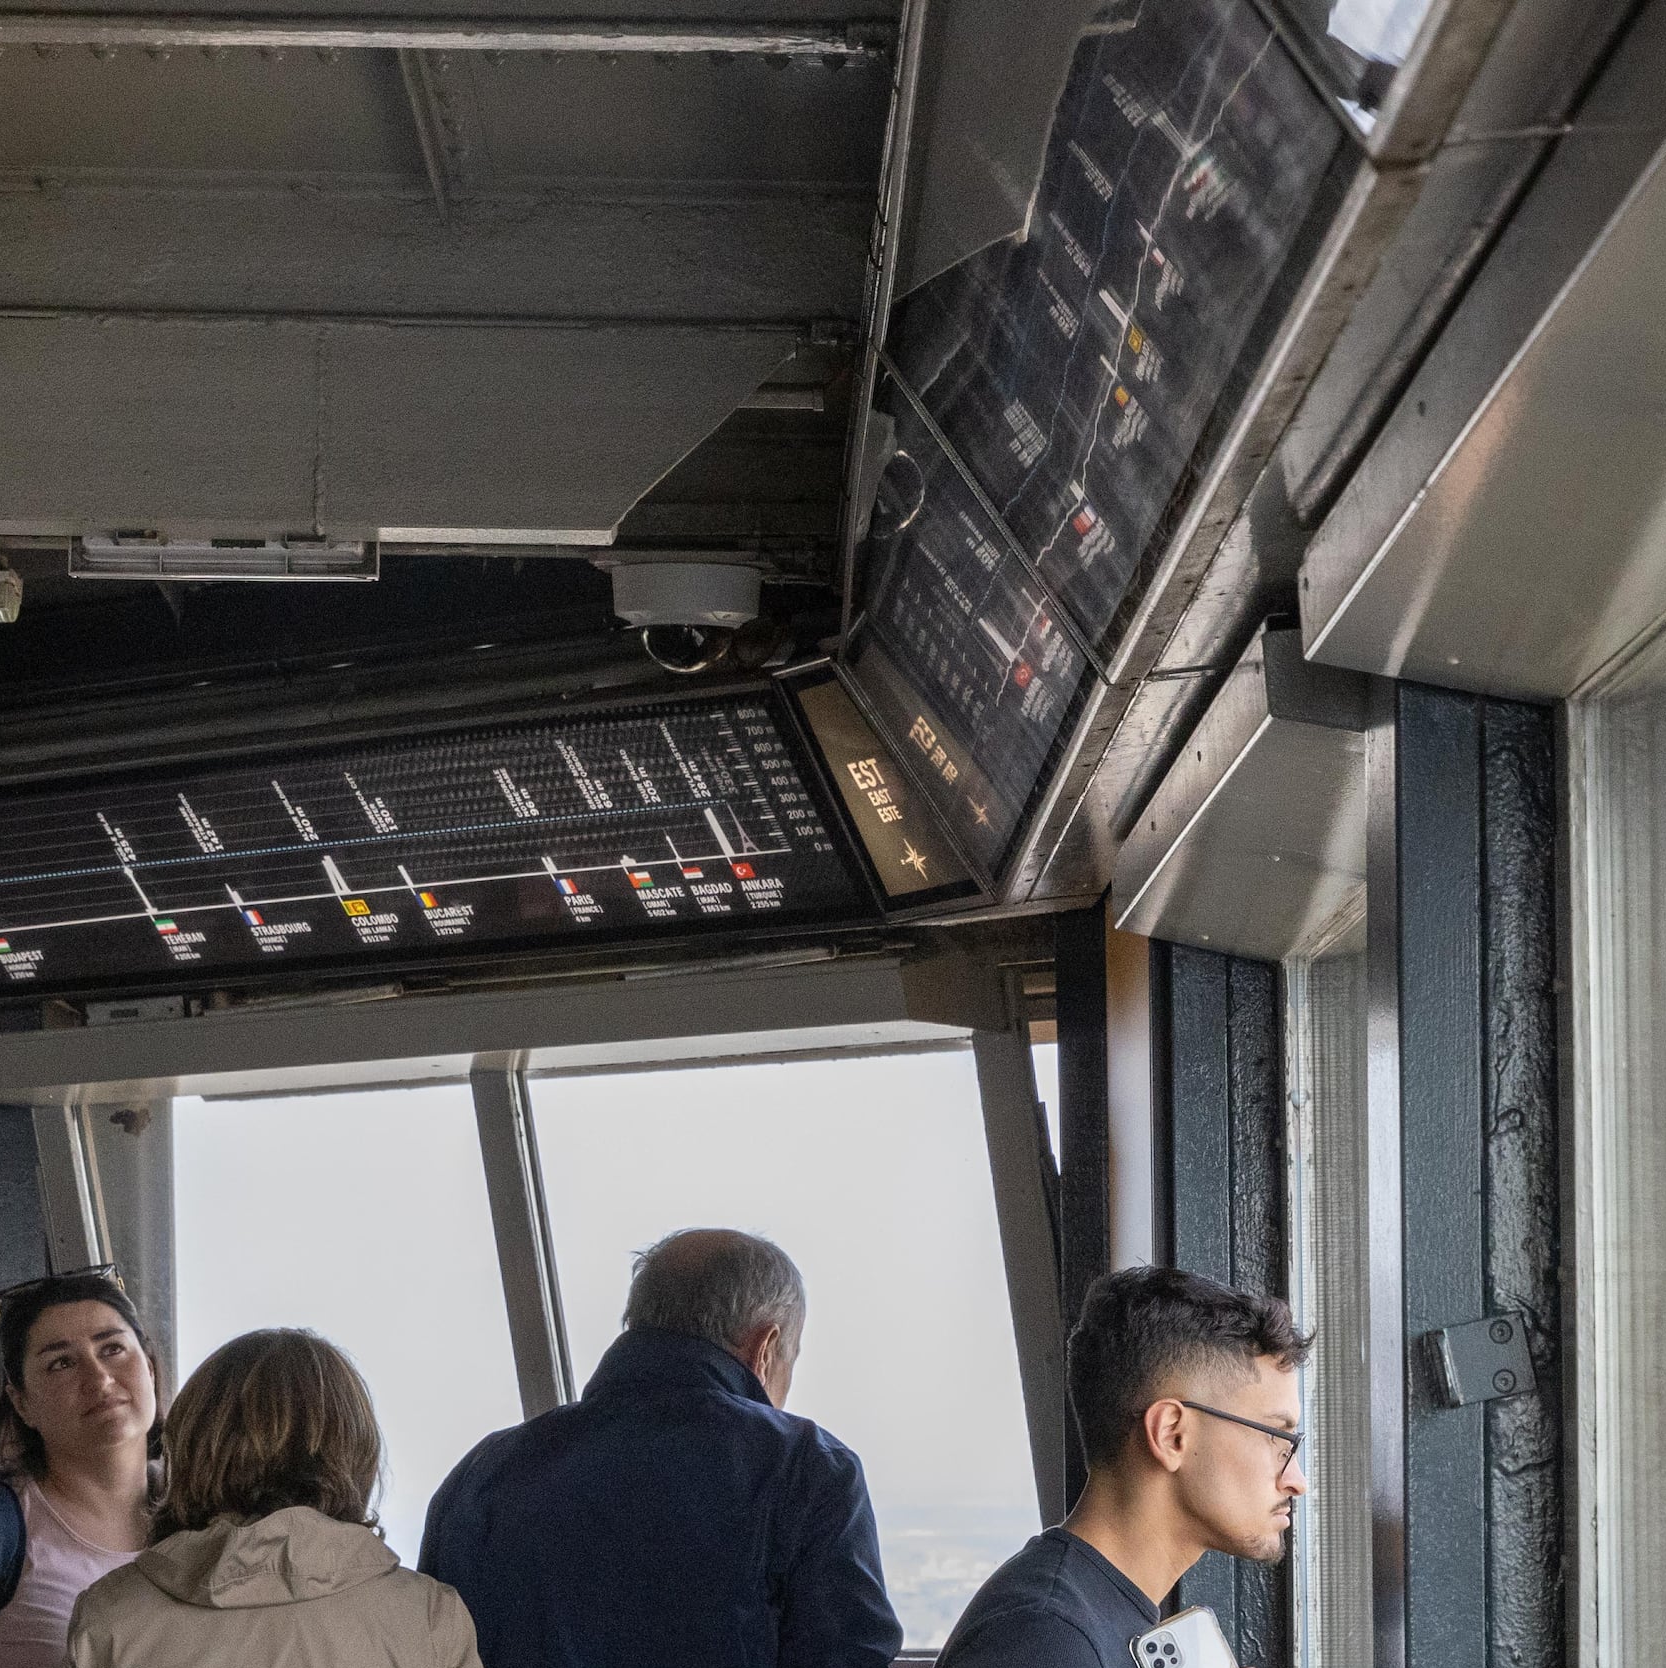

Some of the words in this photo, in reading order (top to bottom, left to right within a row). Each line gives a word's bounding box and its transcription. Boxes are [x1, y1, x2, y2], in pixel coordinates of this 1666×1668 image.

[737, 710, 756, 719] 800
[757, 708, 767, 717] m
[745, 726, 763, 735] 700
[765, 725, 775, 733] m
[657, 720, 682, 760] ISTANBUL
[754, 743, 772, 753] 600
[775, 742, 783, 750] m
[565, 745, 588, 777] QABOOS
[618, 748, 639, 780] BAGDAD
[687, 760, 698, 771] m
[762, 760, 779, 769] 500
[636, 766, 648, 777] m
[847, 758, 885, 790] EST
[343, 771, 358, 789] CITY
[593, 779, 604, 790] m
[678, 761, 701, 798] SKYLAND
[692, 774, 711, 797] 284
[720, 771, 738, 793] 330
[771, 776, 789, 786] 400
[790, 776, 799, 784] m
[519, 788, 530, 798] m
[575, 778, 596, 809] GRANDE
[583, 778, 604, 809] SULTAN
[636, 783, 651, 803] TOUR
[642, 779, 661, 802] 205
[779, 793, 797, 803] 300
[867, 789, 892, 806] EAST
[373, 797, 385, 807] m
[598, 792, 613, 808] 69
[294, 806, 306, 817] m
[525, 800, 540, 816] 96
[788, 810, 805, 819] 200
[877, 806, 903, 823] ESTE
[199, 817, 211, 828] m
[368, 803, 390, 832] CENTER
[379, 809, 399, 831] 130
[112, 827, 124, 838] m
[300, 818, 319, 840] 240
[796, 827, 814, 836] 100
[815, 826, 825, 834] m
[205, 830, 224, 850] 142
[815, 843, 821, 851] 0
[119, 839, 138, 861] 435
[690, 882, 733, 895] BAGDAD
[738, 876, 784, 892] ANKARA
[564, 894, 595, 906] PARIS
[636, 886, 685, 901] MASCATE
[423, 904, 474, 919] BUCAREST
[350, 913, 399, 926] COLOMBO
[250, 921, 311, 937] STRASBOURG
[161, 931, 205, 945] TÉHÉRAN
